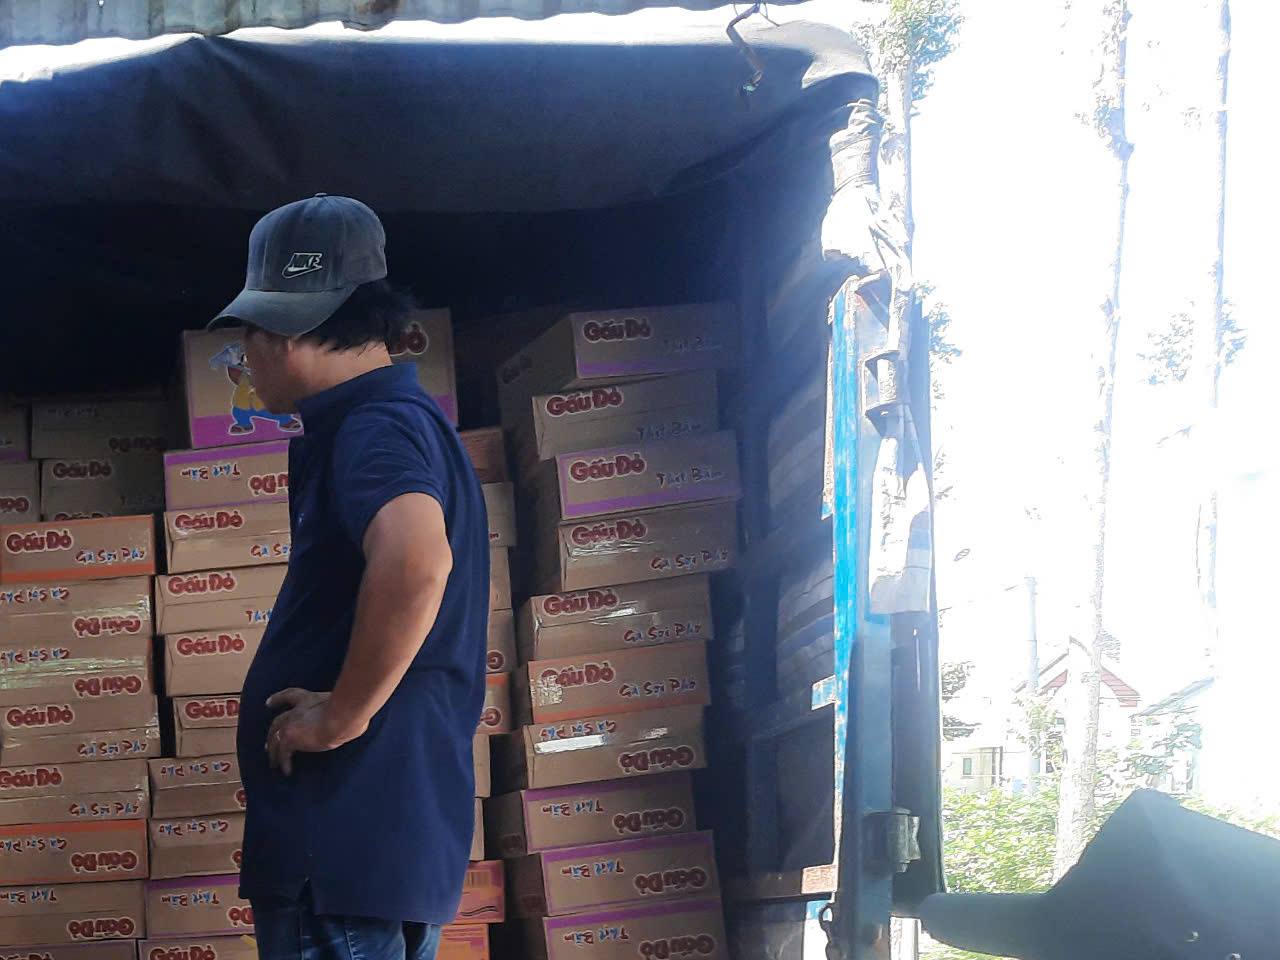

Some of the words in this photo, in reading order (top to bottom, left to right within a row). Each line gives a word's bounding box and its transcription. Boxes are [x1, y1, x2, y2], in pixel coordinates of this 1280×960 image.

[547, 395, 591, 416] Gấu
[593, 387, 623, 407] Đỏ
[571, 459, 615, 481] Gấu
[616, 455, 646, 474] Đỏ
[175, 514, 215, 530] Gấu
[217, 511, 243, 527] Đỏ
[6, 532, 44, 552] Gấu
[46, 531, 72, 548] Đỏ
[572, 523, 616, 545] Gấu
[616, 519, 647, 539] Đỏ
[168, 575, 208, 595] Gấu
[209, 572, 236, 591] Đỏ
[544, 596, 587, 615] Gấu
[588, 589, 619, 610] Đỏ
[177, 637, 217, 655] Gấu
[218, 634, 245, 653] Đỏ
[6, 707, 45, 727] Gấu
[47, 705, 73, 724] Đỏ
[71, 853, 97, 872] Đỏ
[97, 851, 138, 871] Gấu
[69, 921, 95, 939] Đỏ
[95, 918, 135, 937] Gấu
